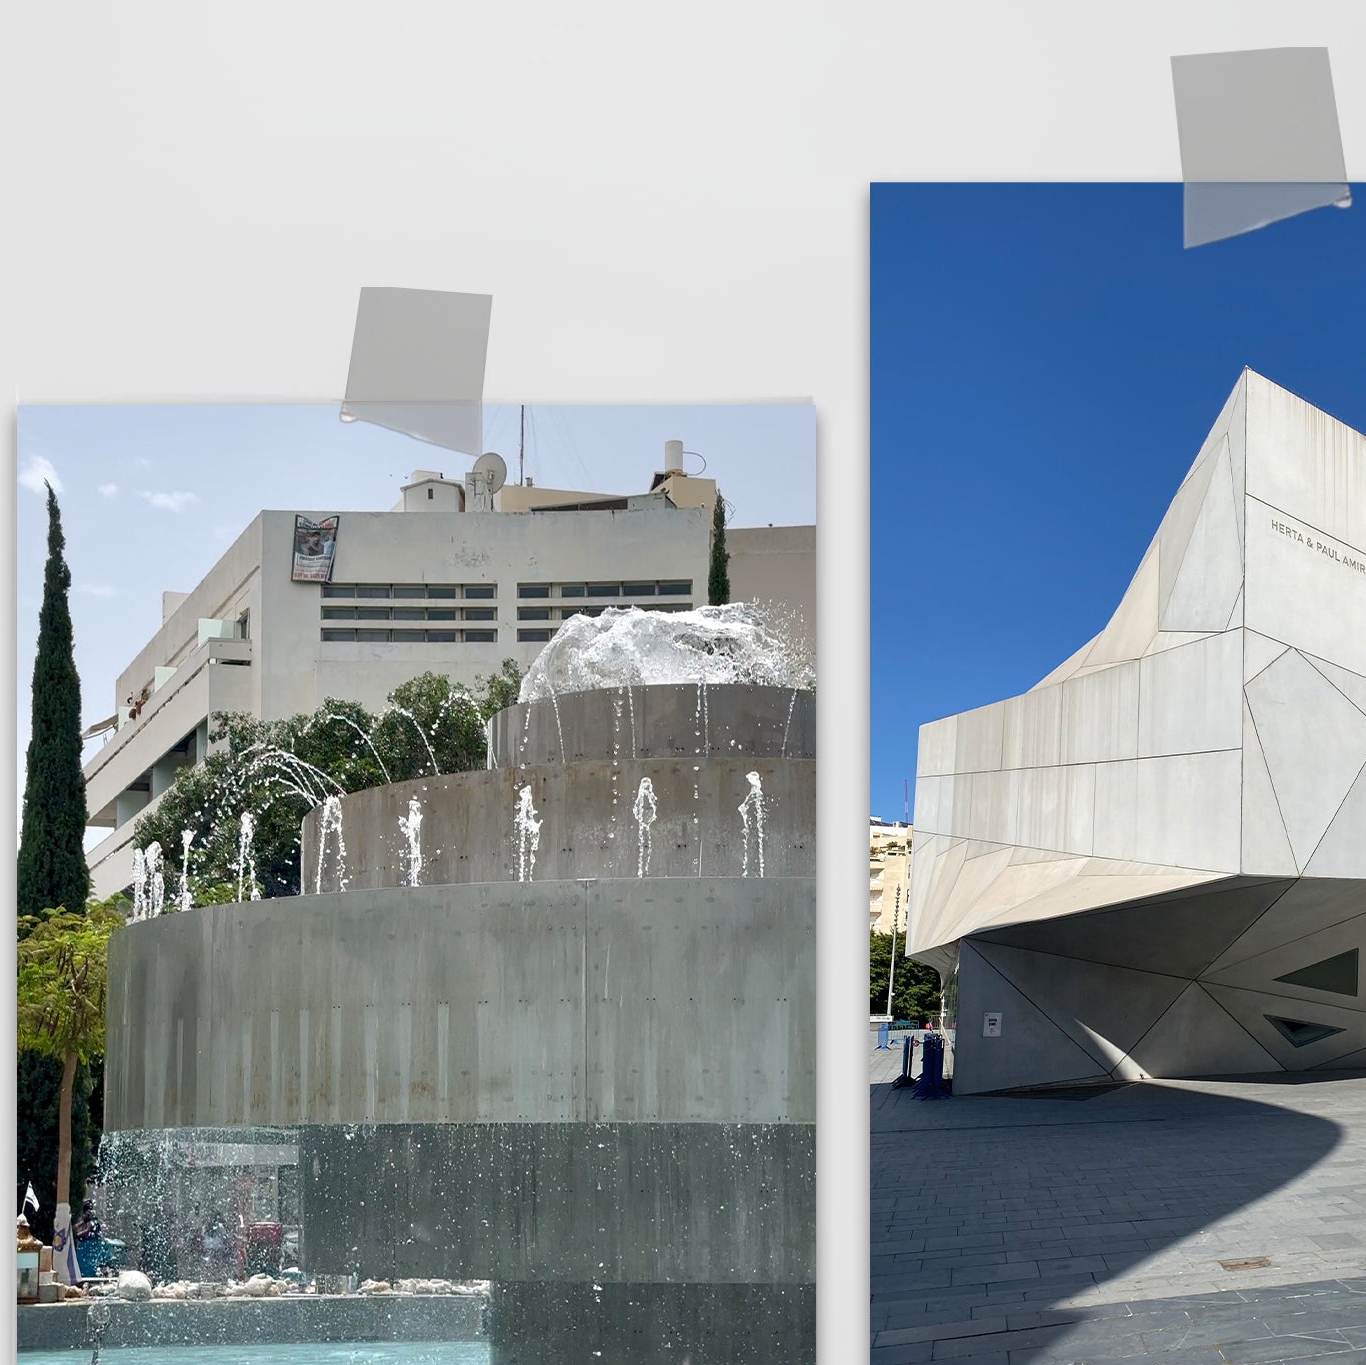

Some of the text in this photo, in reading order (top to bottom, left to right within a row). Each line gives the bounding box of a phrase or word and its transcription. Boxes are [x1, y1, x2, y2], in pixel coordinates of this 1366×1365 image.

[1271, 519, 1304, 544] HERTA
[1306, 537, 1314, 549] &
[1316, 541, 1340, 562] PAUL
[1342, 555, 1366, 575] AMIR
